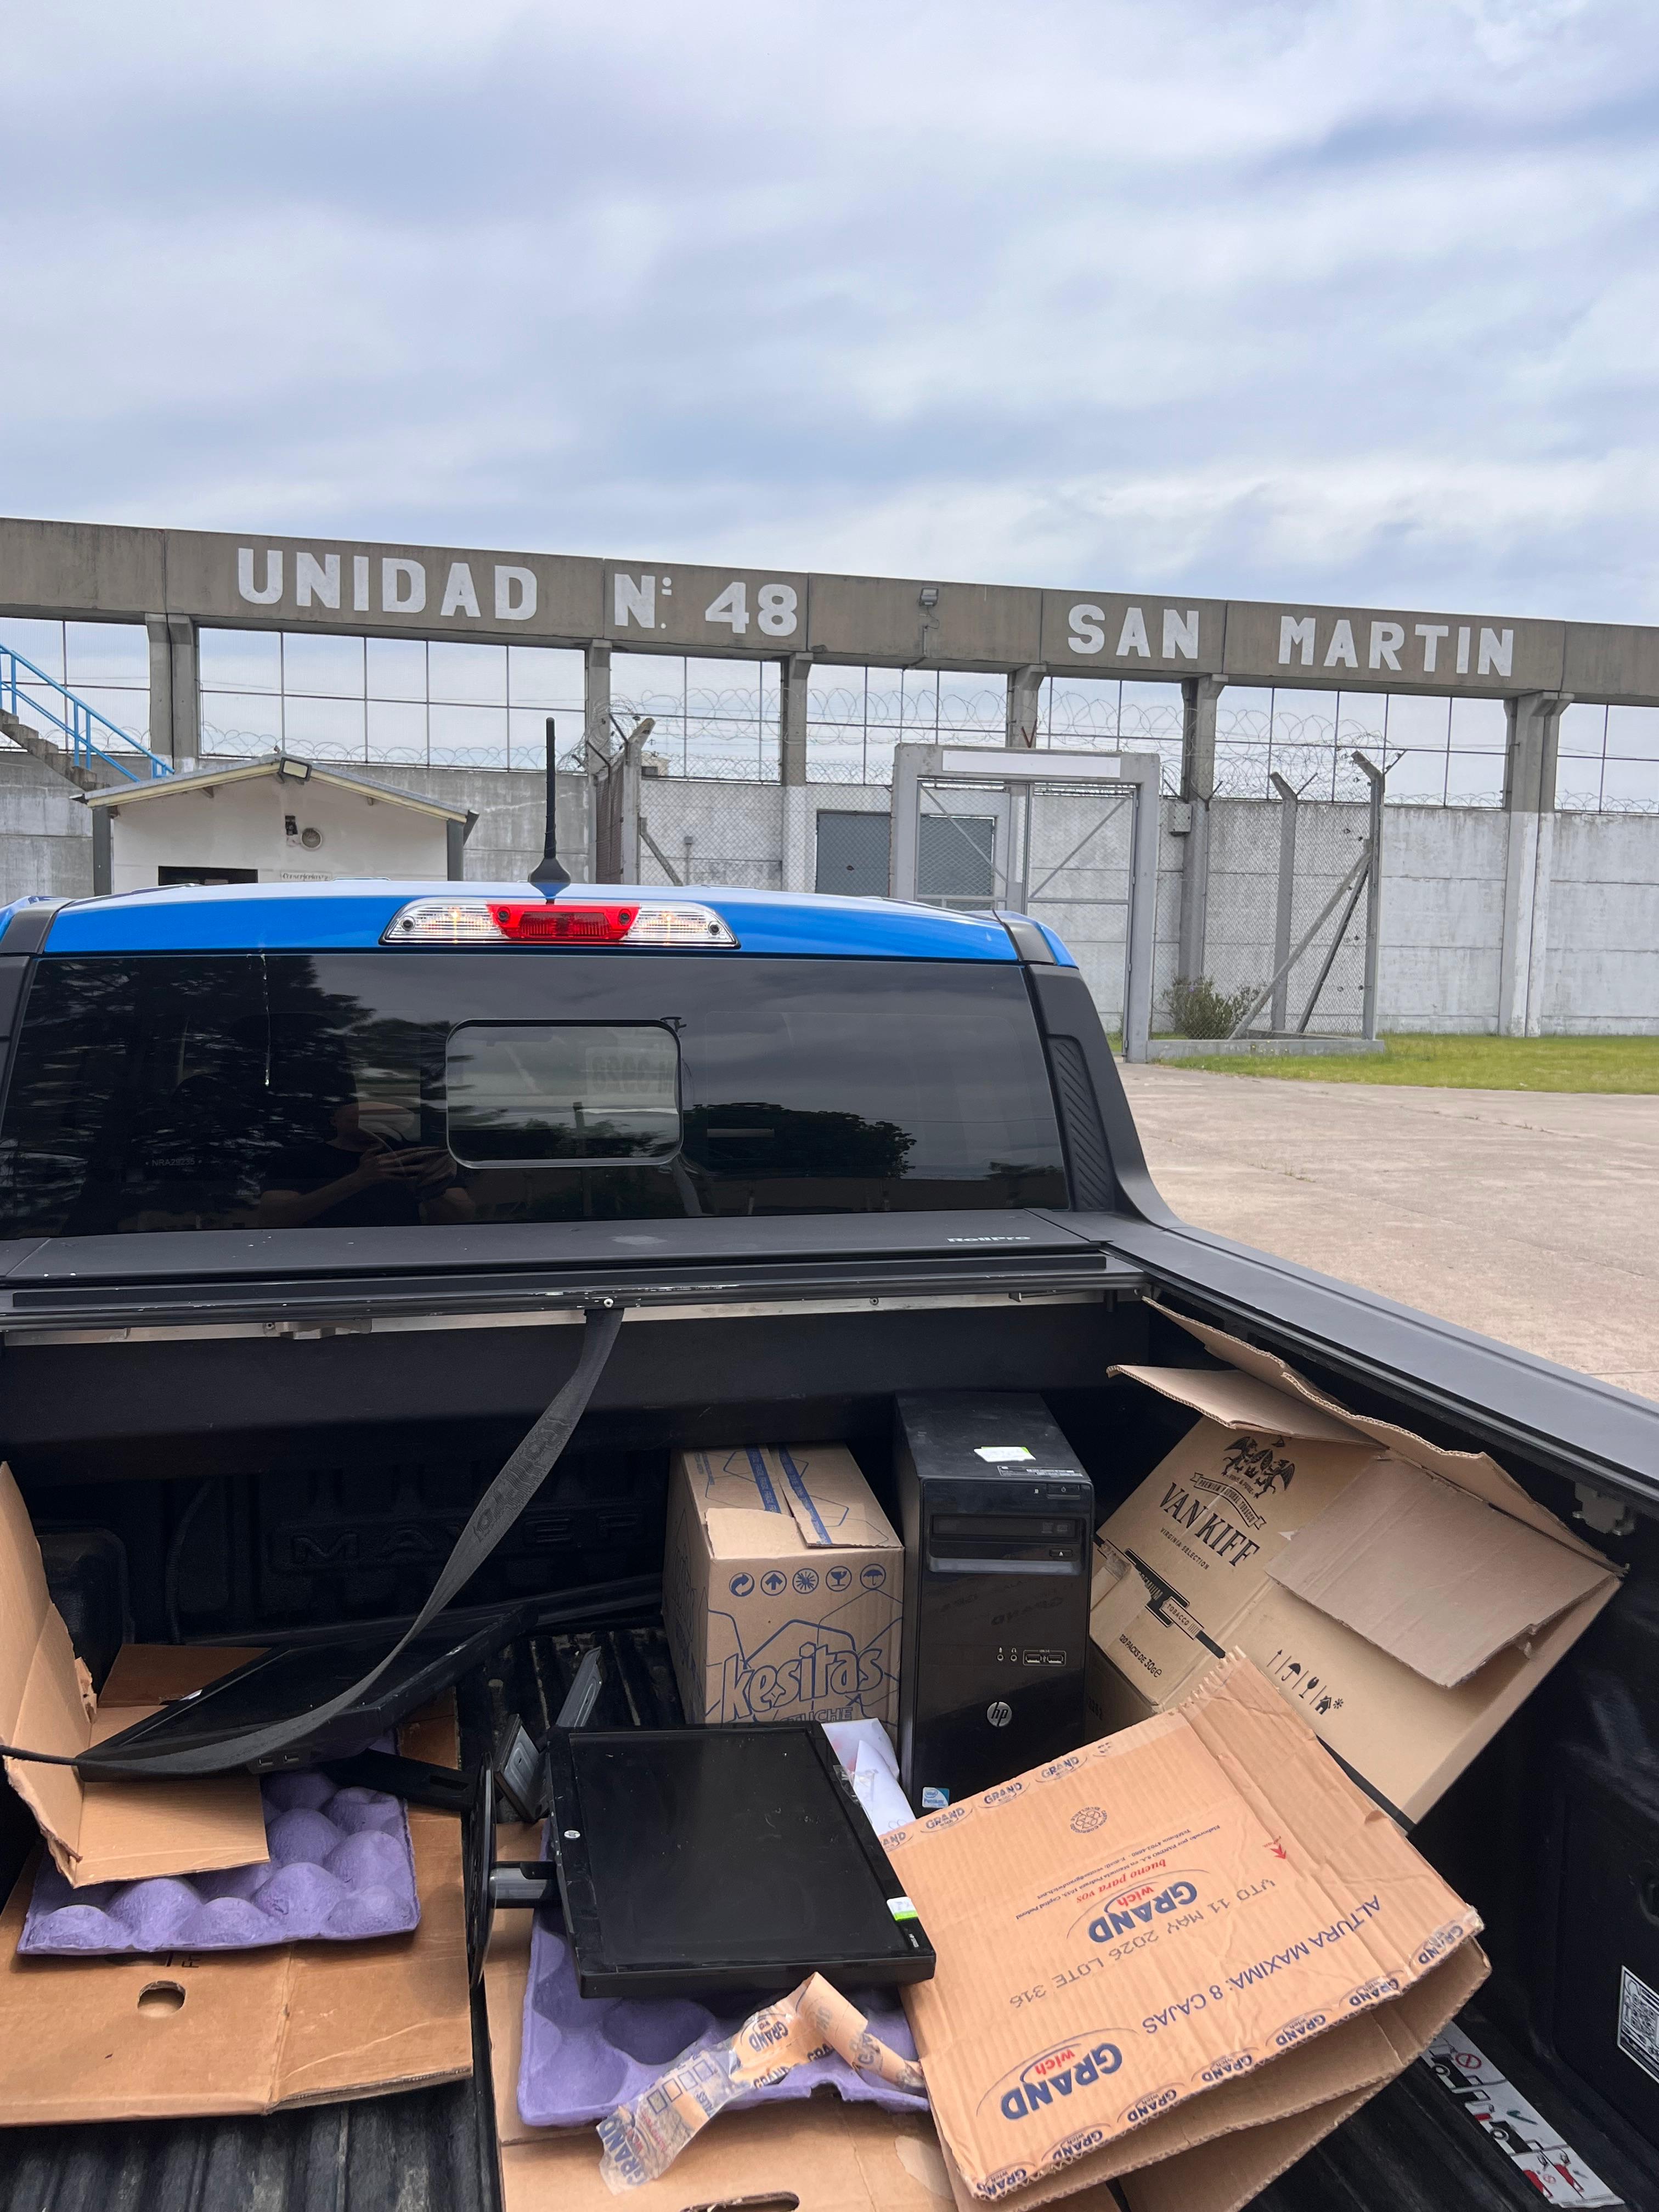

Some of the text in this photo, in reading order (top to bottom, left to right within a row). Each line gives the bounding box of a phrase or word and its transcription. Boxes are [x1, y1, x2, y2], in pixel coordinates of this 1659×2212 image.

[238, 548, 537, 620] UNIDAD
[706, 582, 797, 636] 48
[1068, 604, 1514, 676] SAN MARTIN
[1159, 1482, 1260, 1567] VAN KIFF
[1160, 1527, 1210, 1570] VIRGINIA SELECTION
[1166, 1603, 1190, 1626] TOBACCO
[1125, 1640, 1139, 1658] PACKS
[1137, 1652, 1147, 1664] DE
[720, 1643, 884, 1722] kesitas
[990, 1701, 1010, 1728] hp
[1040, 1755, 1081, 1779] GRAND
[983, 1781, 1024, 1805] GRAND
[924, 1805, 966, 1830] GRAND
[879, 1831, 907, 1848] AND
[1075, 1858, 1167, 1904] bueno para vos
[1115, 1884, 1155, 1909] wich
[1087, 1881, 1196, 1941] GRAND
[1008, 1874, 1276, 2011] VTO 11 MAY 2026 LOTE 316
[1140, 1894, 1381, 2035] ALTURA MAXIMA: 8 CAJAS
[748, 2020, 789, 2053] GRAND
[1274, 2012, 1328, 2047] GRAND
[1032, 2046, 1077, 2078] wich
[1199, 2052, 1254, 2084] GRAND
[998, 2041, 1121, 2123] GRAND
[1125, 2087, 1179, 2123] GRAND
